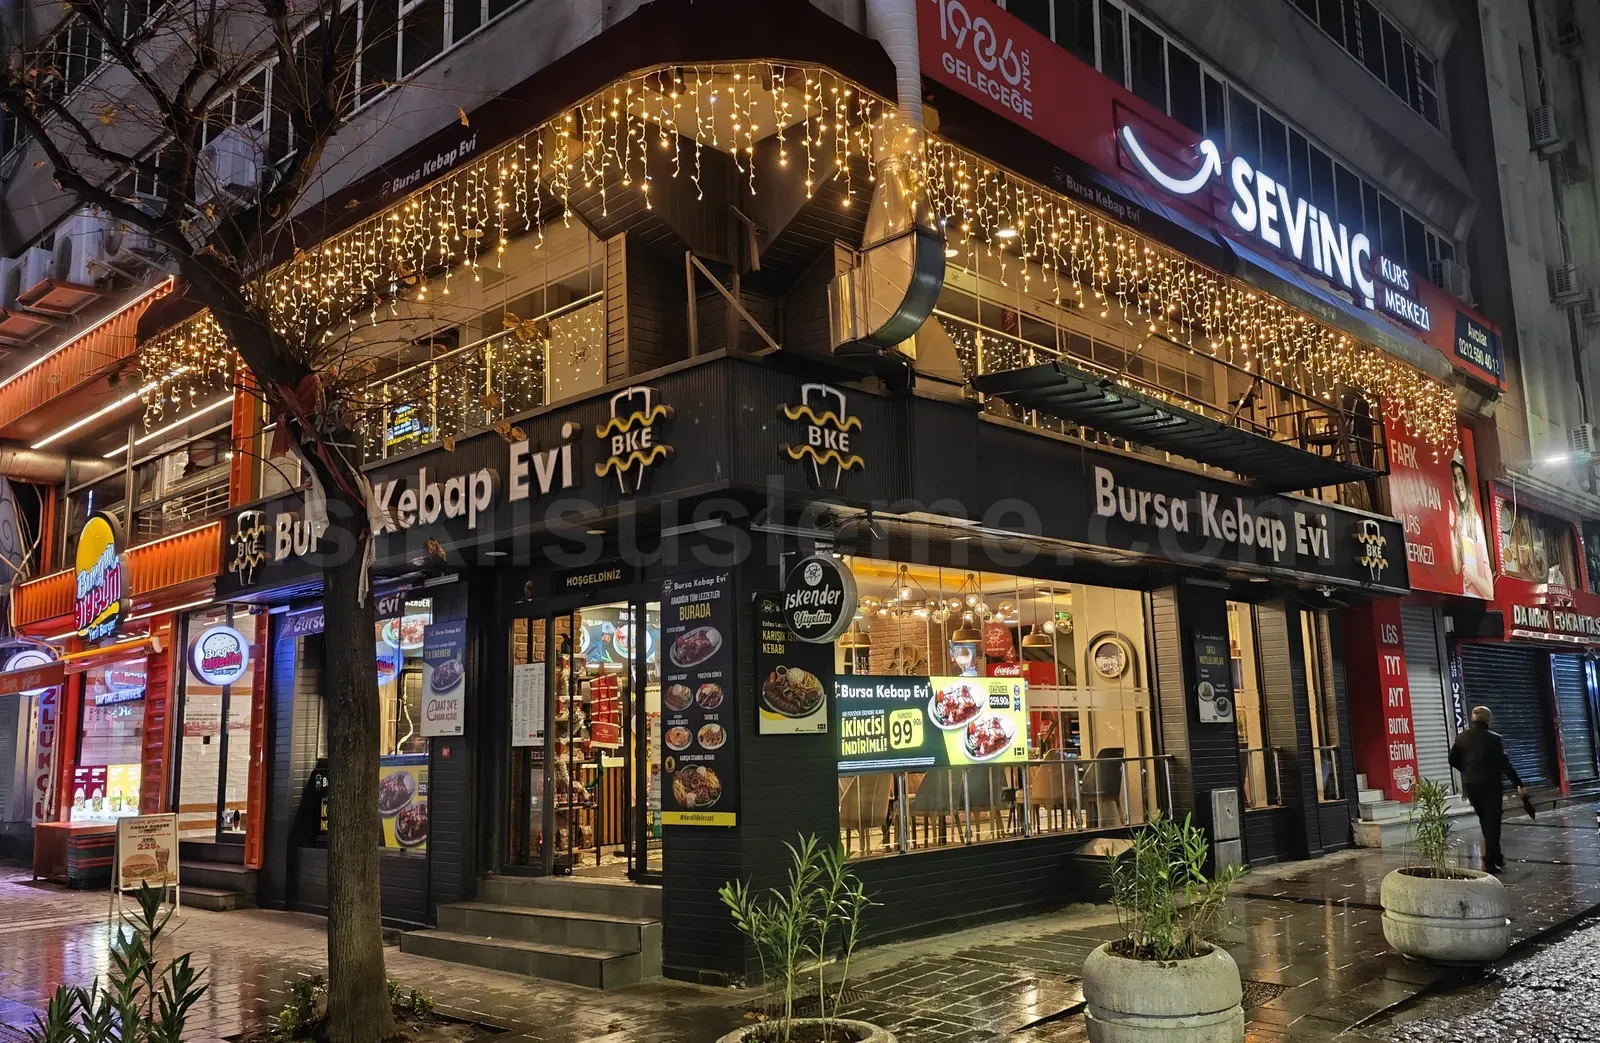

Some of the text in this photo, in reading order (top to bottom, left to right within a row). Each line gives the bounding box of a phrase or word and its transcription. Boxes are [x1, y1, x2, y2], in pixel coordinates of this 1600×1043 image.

[942, 52, 1033, 121] GELECEĞE
[392, 133, 477, 193] Bursa Kebap Evi
[1066, 175, 1141, 224] Bursa Kebap Evi
[1381, 255, 1410, 296] KURS
[1385, 287, 1431, 332] MERKEZİ
[612, 425, 654, 457] BKE
[807, 425, 850, 454] BKE
[1390, 439, 1419, 471] FARK
[373, 465, 494, 536] Kebap
[508, 421, 573, 504] Evi
[1093, 465, 1330, 563] Bursa Kebap Evi
[237, 540, 258, 558] BKE
[1365, 543, 1382, 559] BKE
[77, 542, 120, 599] Burger
[566, 568, 622, 588] HOŞGELDİNİZ
[674, 574, 726, 590] Bursa Kebap Evi
[378, 592, 401, 616] Evi
[679, 602, 711, 621] BURADA
[1513, 604, 1551, 629] DAMAK
[99, 620, 117, 638] Burger
[1380, 623, 1399, 645] LGS
[205, 643, 240, 660] Burger
[762, 642, 785, 655] KEBABI
[1384, 655, 1401, 676] TYT
[841, 684, 929, 701] Bursa Kebap Evi
[1388, 687, 1404, 707] AYT
[435, 700, 446, 711] SAAT
[841, 715, 885, 738] İKİNCİSİ
[892, 720, 913, 746] 99
[1388, 714, 1410, 735] BUTİK
[841, 736, 888, 756] İNDİRİMLİ!
[1389, 740, 1415, 761] EĞİTİM
